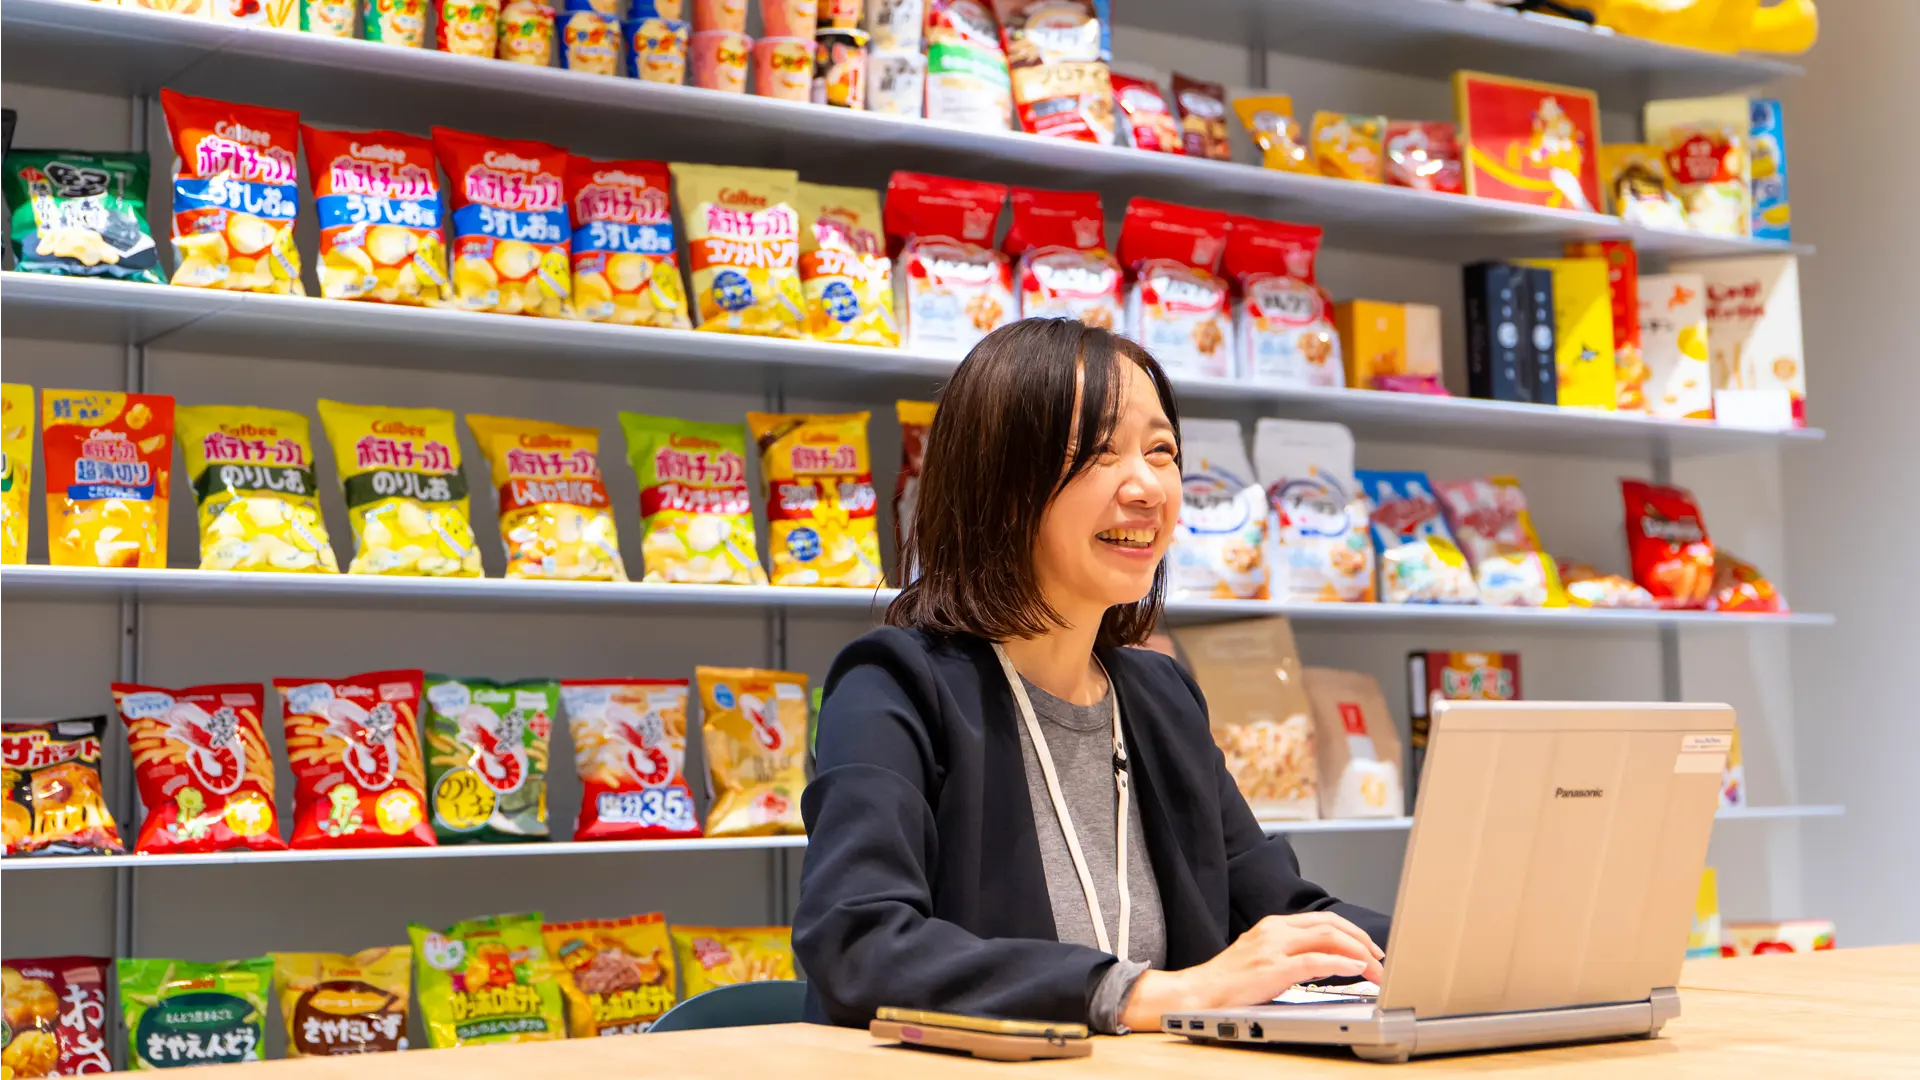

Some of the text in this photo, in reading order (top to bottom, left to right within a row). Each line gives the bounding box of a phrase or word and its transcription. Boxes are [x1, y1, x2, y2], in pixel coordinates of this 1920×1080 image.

[215, 121, 271, 145] Calbee
[331, 156, 436, 199] ポテトチップス
[466, 165, 564, 212] ポテトチップス
[219, 423, 277, 437] Calbee
[371, 420, 426, 437] Calbee
[519, 433, 572, 449] Calbee
[203, 431, 308, 467] ポテトチップス
[356, 435, 456, 472] ポテトチップス
[220, 465, 306, 494] のりしお
[372, 471, 451, 500] のりしお
[1555, 787, 1604, 798] Panasonic
[146, 1027, 257, 1062] さやえんどう
